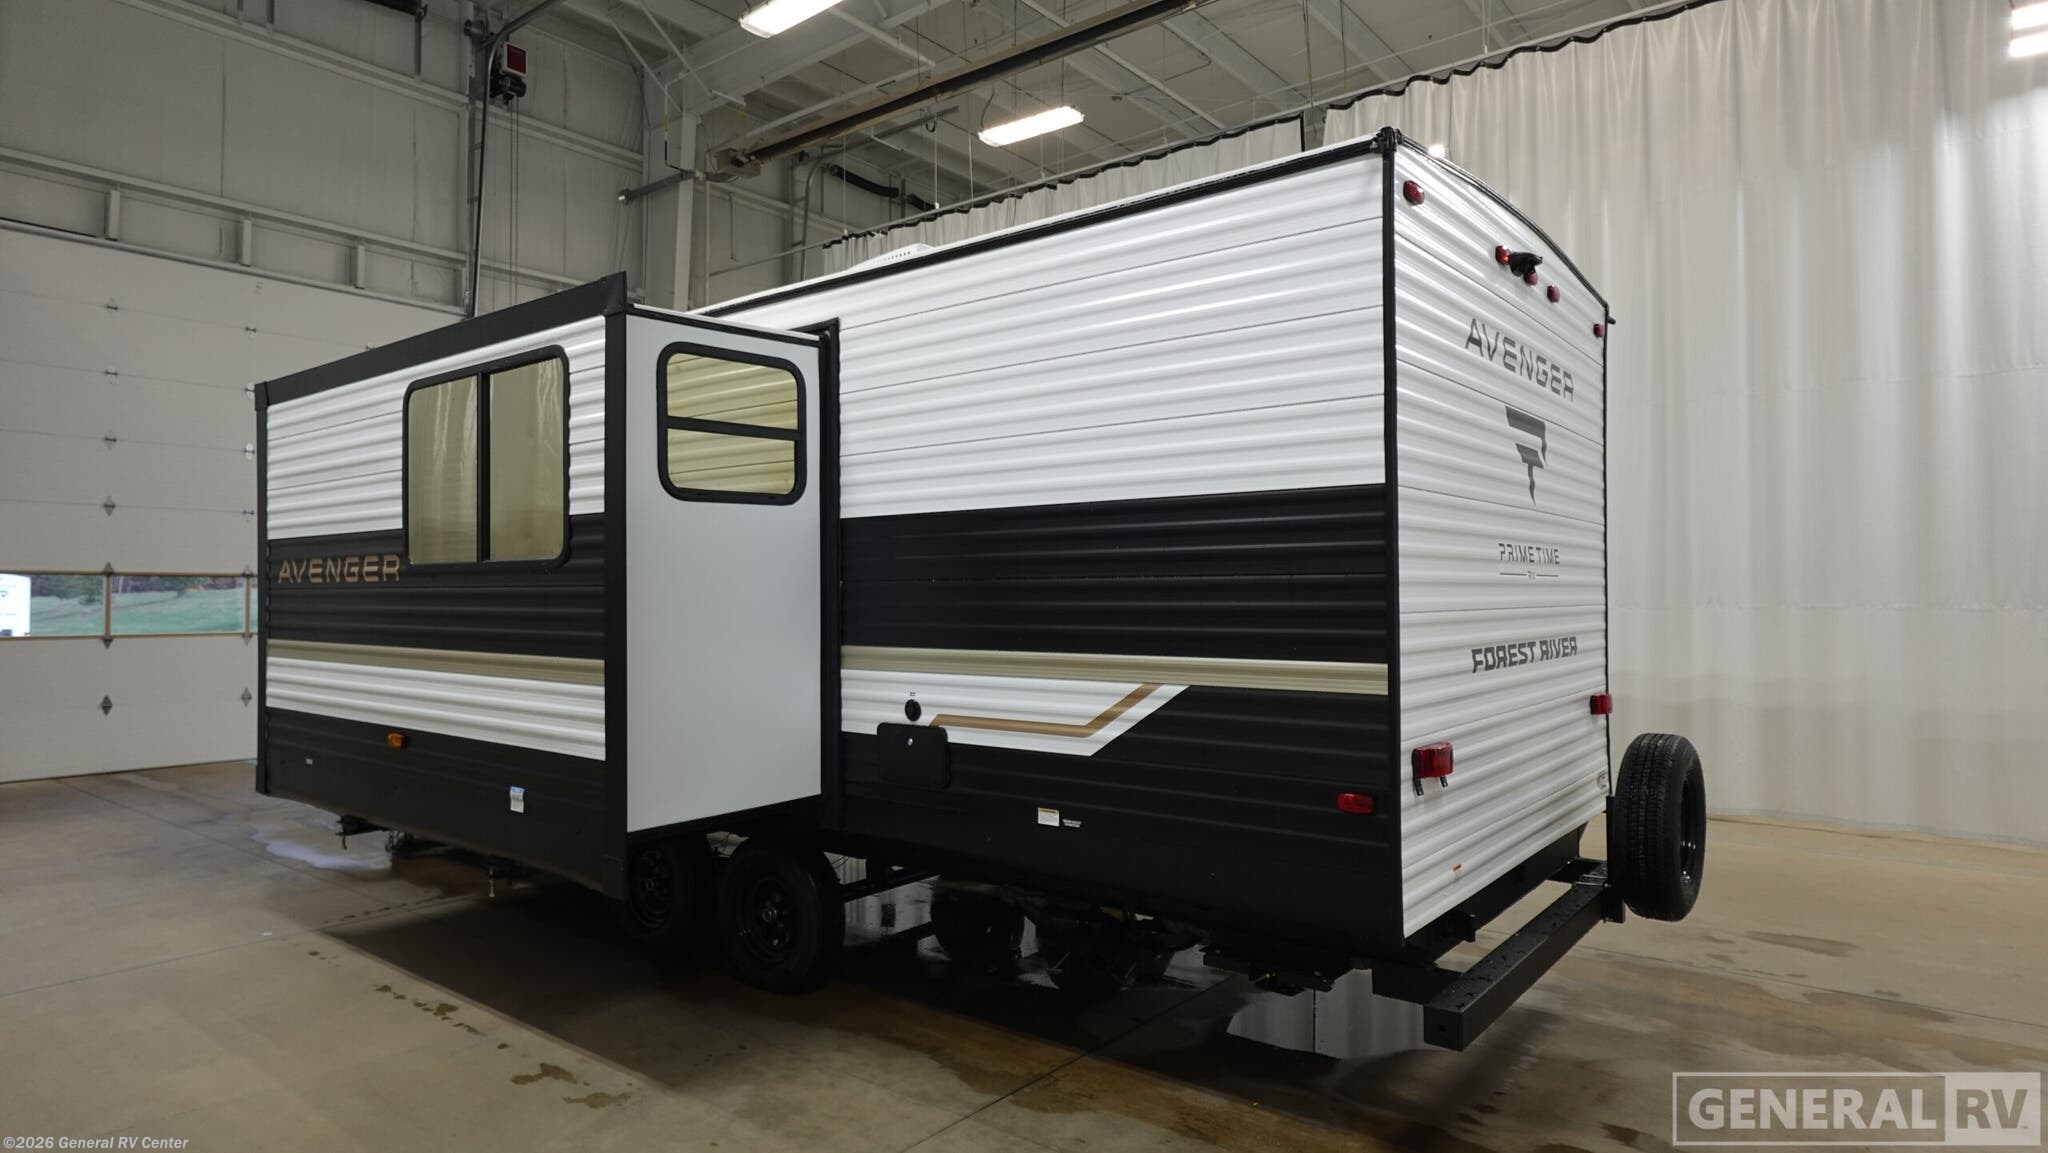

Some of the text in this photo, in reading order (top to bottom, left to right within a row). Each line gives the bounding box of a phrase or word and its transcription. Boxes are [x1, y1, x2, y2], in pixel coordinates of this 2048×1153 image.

[1465, 318, 1574, 402] AVENGER
[279, 554, 400, 584] AVENGER
[1471, 636, 1578, 674] FOREST RIVER
